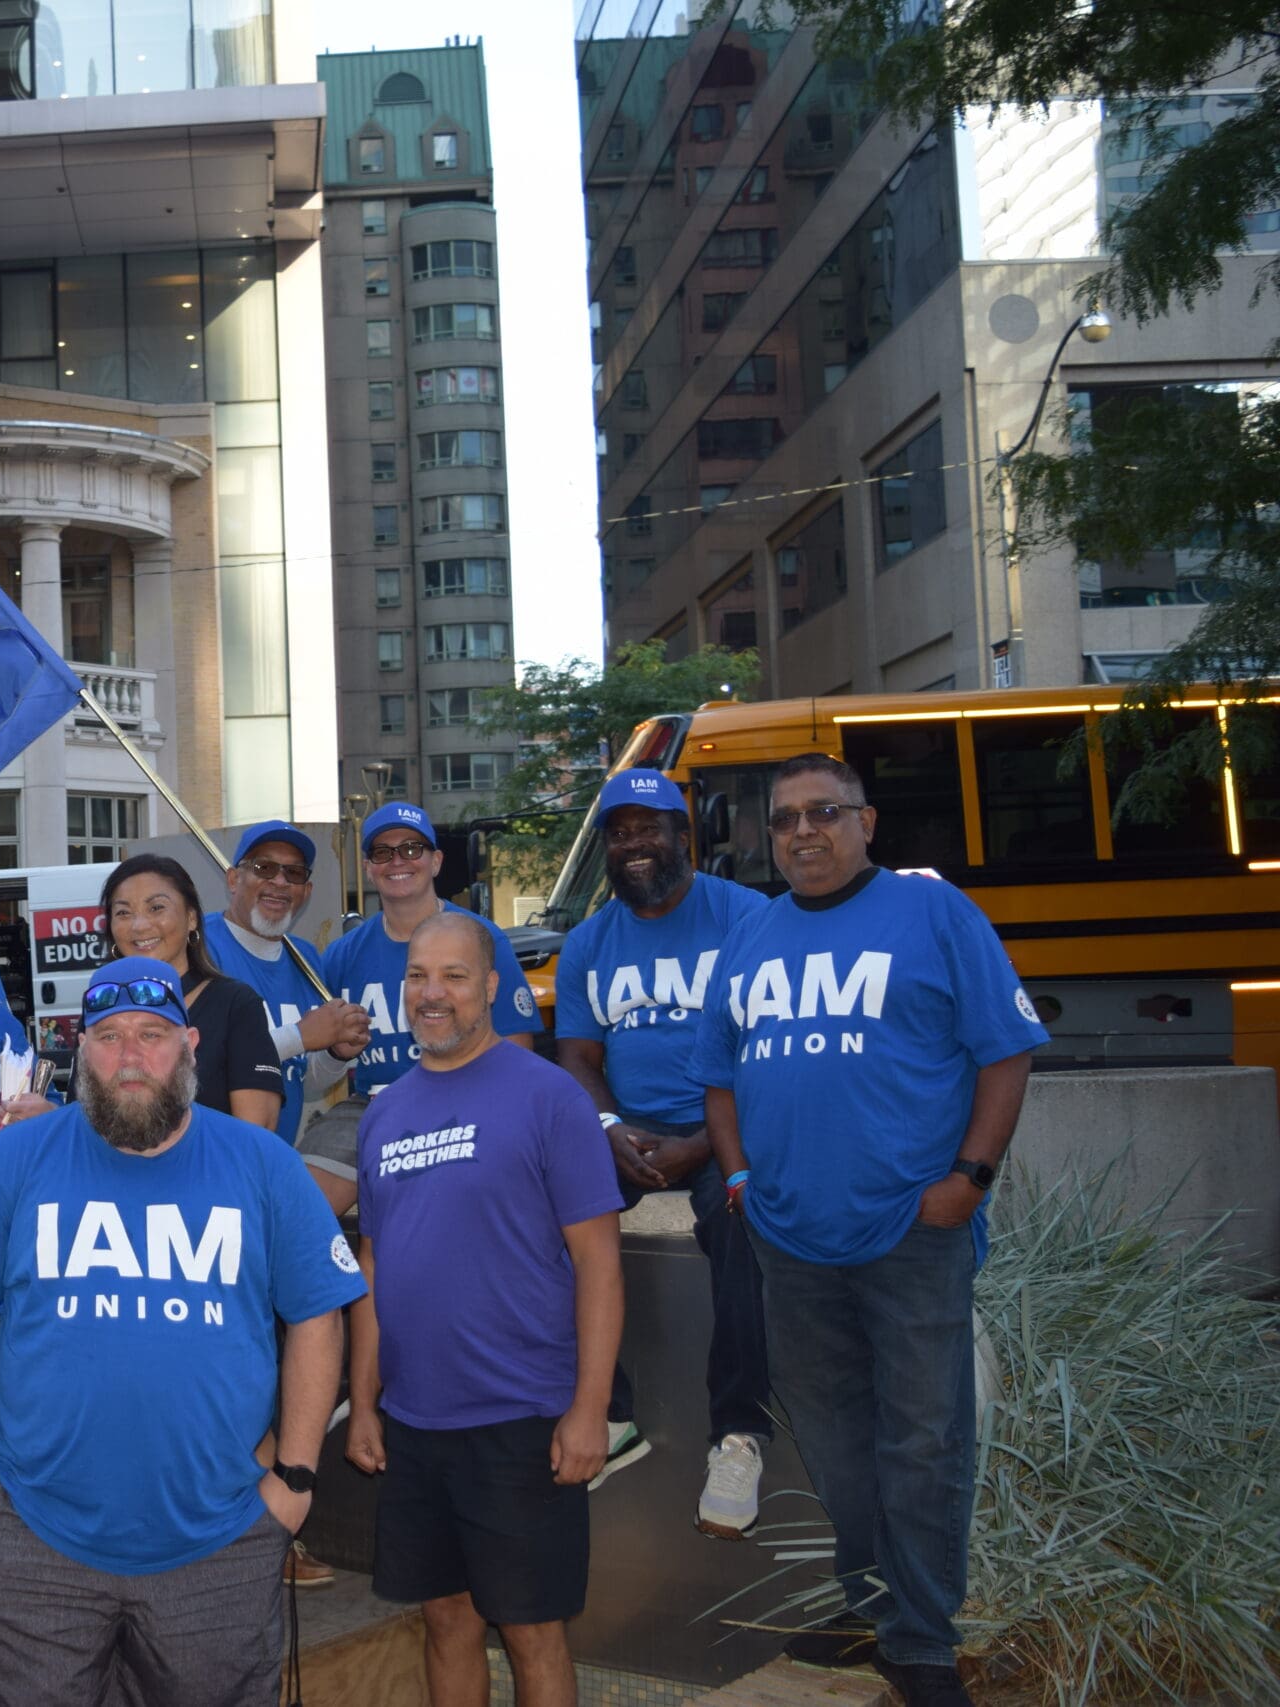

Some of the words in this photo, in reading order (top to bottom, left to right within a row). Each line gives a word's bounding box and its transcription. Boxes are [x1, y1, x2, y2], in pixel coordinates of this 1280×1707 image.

[631, 778, 659, 788] IAM
[398, 808, 422, 822] IAM
[51, 916, 88, 937] NO
[85, 934, 99, 942] to
[729, 951, 893, 1031] IAM
[358, 1043, 421, 1066] UNIO
[741, 1033, 864, 1064] UNION
[381, 1124, 476, 1160] WORKERS
[379, 1142, 475, 1177] TOGETHER
[36, 1201, 242, 1286] IAM
[57, 1294, 224, 1326] UNION
